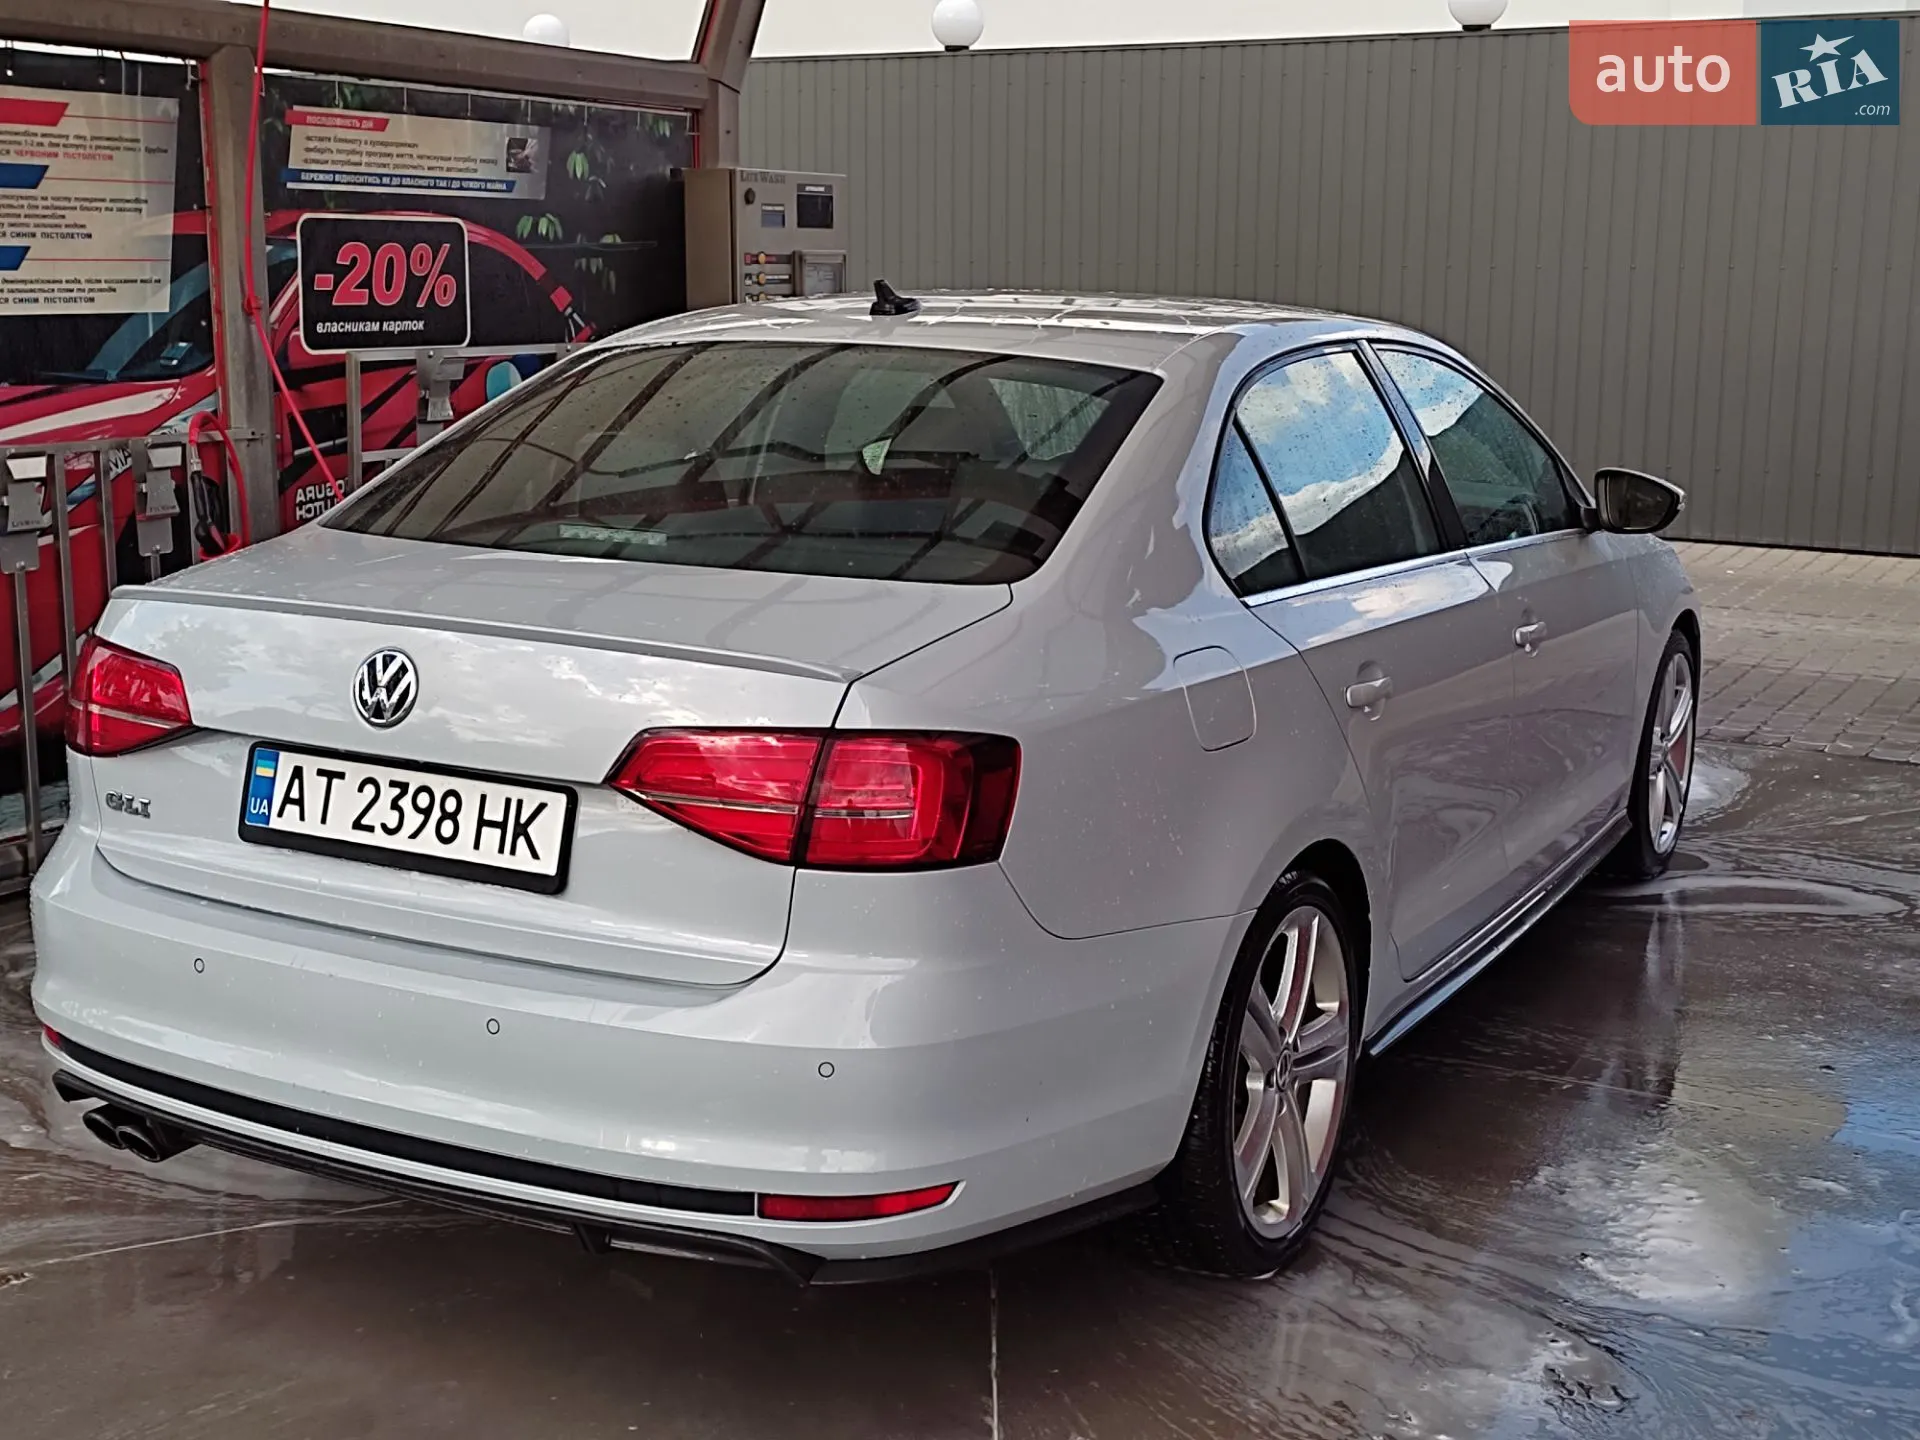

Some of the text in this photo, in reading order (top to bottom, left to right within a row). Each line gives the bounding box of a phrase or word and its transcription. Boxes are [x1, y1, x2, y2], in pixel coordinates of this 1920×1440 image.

[0, 148, 10, 156] СЯ
[301, 171, 334, 182] БЕРЕЖНО
[334, 173, 381, 184] ВІДНОСИТИСЬ
[391, 176, 401, 186] ДО
[401, 177, 435, 187] ВЛАСНОГО
[10, 231, 37, 239] СИНІМ
[41, 231, 92, 240] ПІСТОЛЕТОМ
[314, 242, 457, 307] -20%
[13, 296, 39, 305] СИНІМ
[43, 295, 96, 305] ПІСТОЛЕТОМ
[316, 320, 425, 335] власникам карток
[106, 790, 151, 819] GLI
[250, 796, 269, 817] UA
[276, 764, 549, 861] AT 2398 HK
